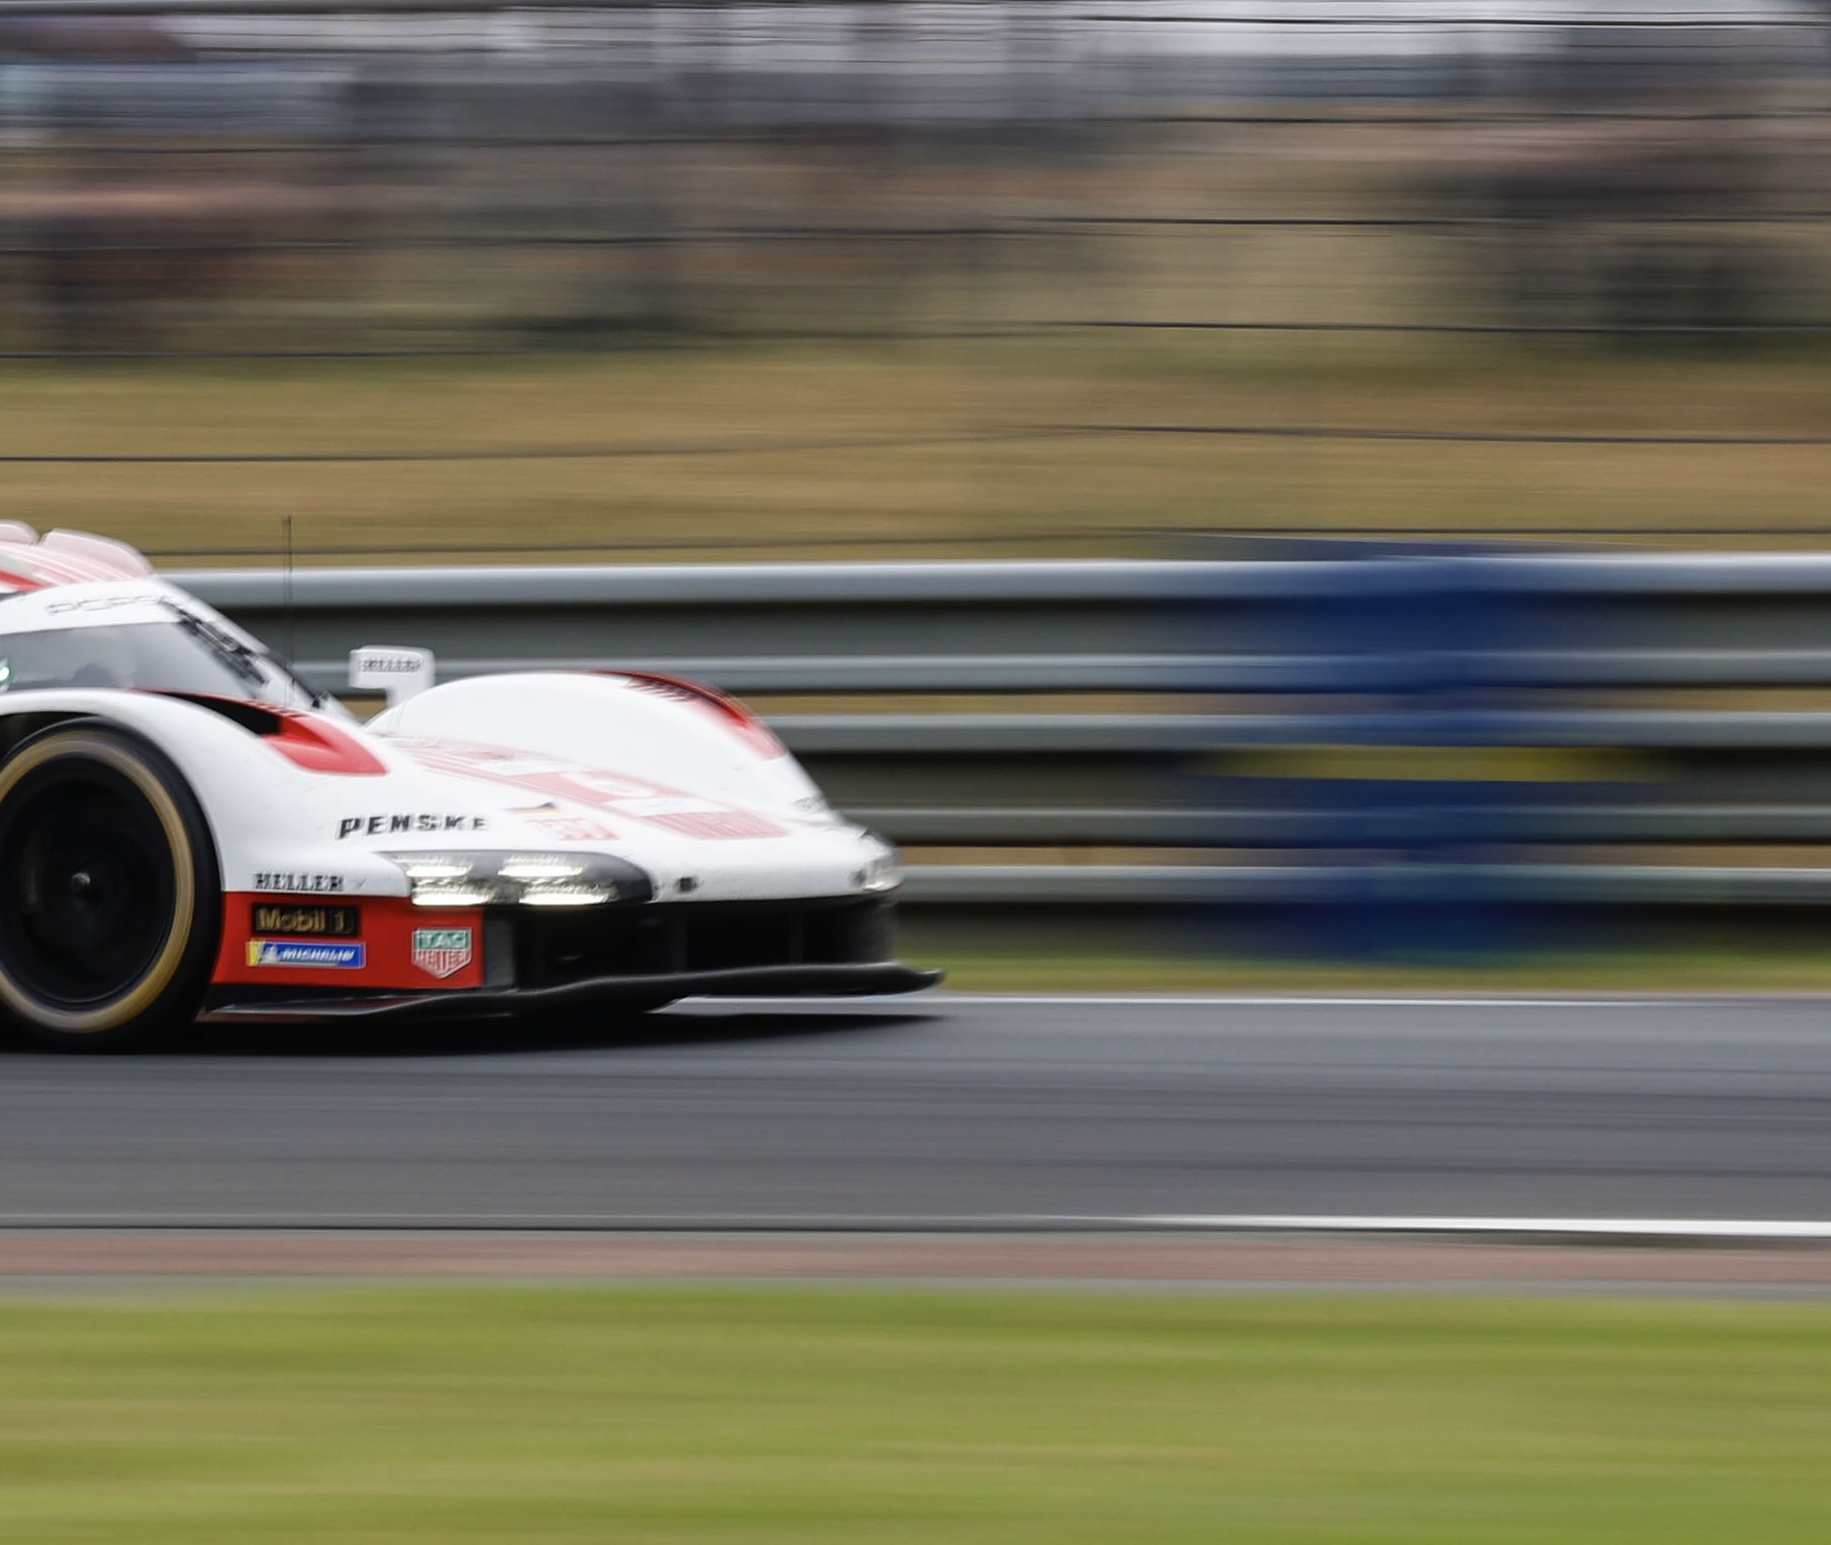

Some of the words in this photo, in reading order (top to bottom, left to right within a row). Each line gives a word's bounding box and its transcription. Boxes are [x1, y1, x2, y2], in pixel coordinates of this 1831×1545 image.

[337, 813, 489, 840] PENSKE
[255, 872, 343, 892] HELLER
[256, 907, 326, 932] Mobil
[277, 946, 355, 963] MICHELIN
